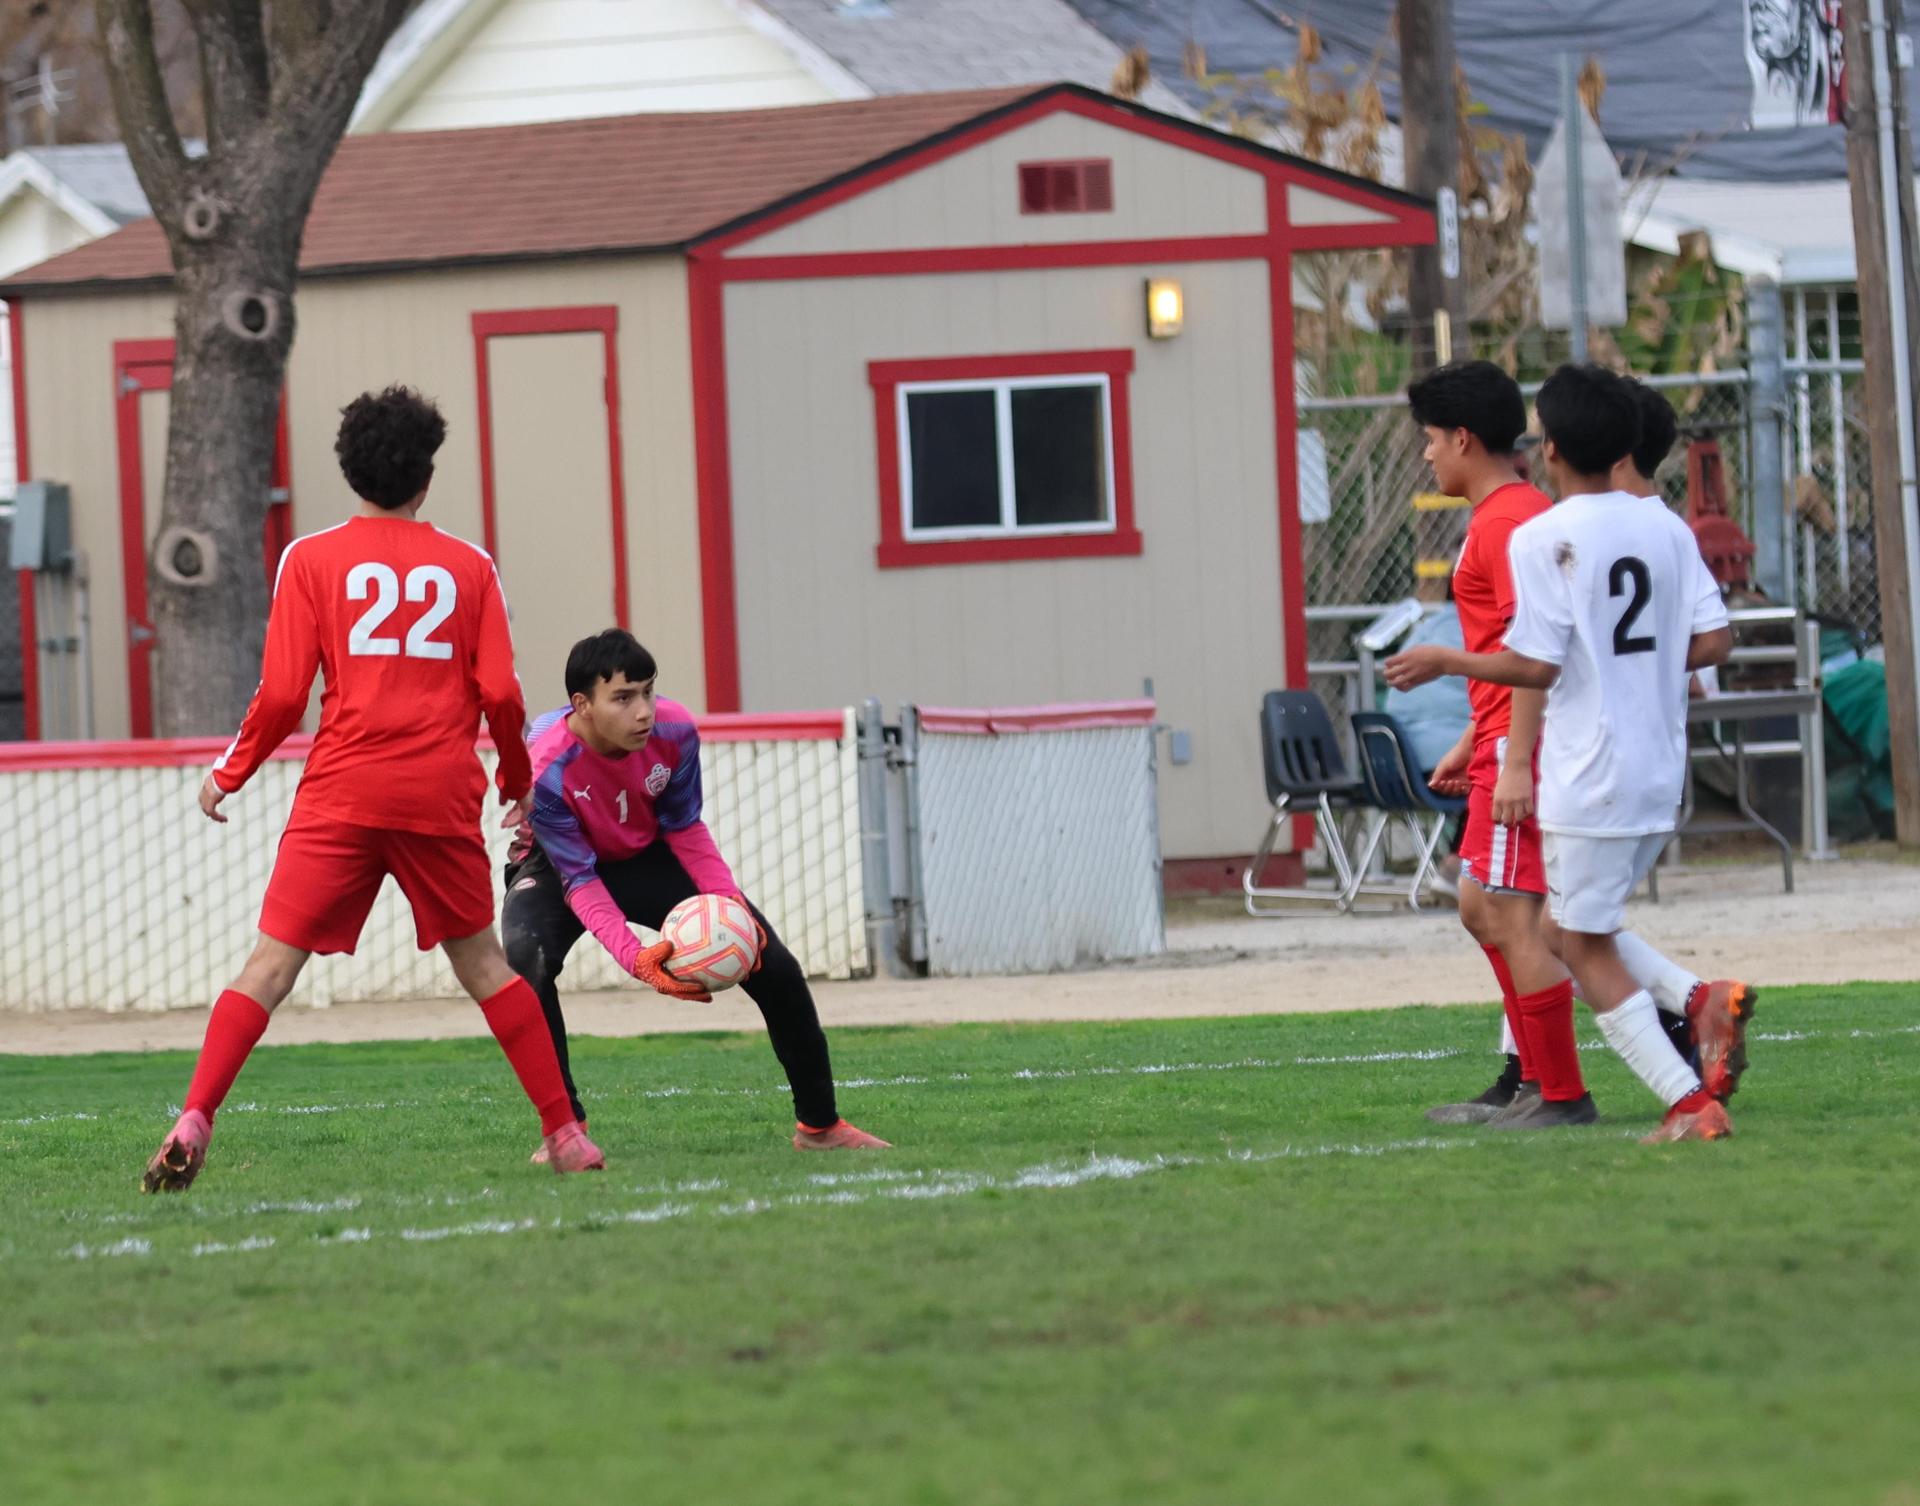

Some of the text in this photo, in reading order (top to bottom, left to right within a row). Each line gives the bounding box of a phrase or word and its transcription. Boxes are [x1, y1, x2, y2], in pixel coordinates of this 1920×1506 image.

[346, 561, 457, 660] 22
[1608, 556, 1656, 656] 2
[615, 789, 629, 824] 1
